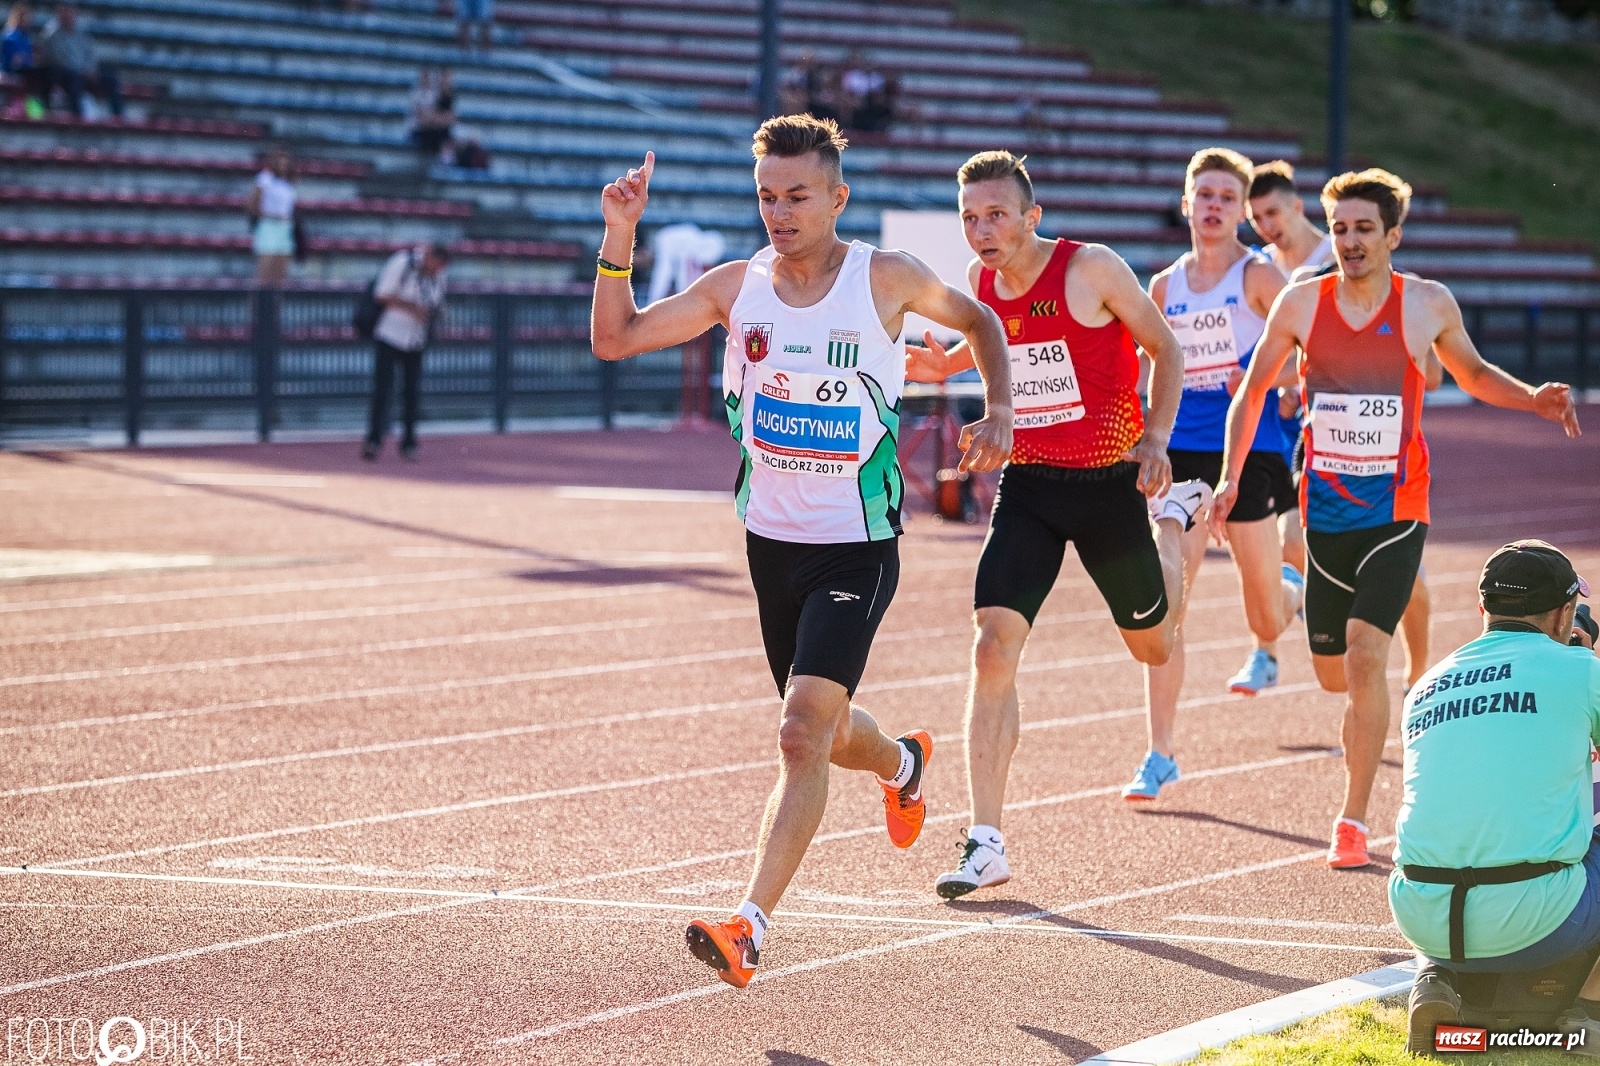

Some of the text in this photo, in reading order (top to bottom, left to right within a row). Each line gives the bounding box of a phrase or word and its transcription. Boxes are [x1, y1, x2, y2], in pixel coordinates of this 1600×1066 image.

[1193, 311, 1227, 331] 606
[1028, 345, 1065, 366] 548
[763, 385, 788, 399] ORLEN
[815, 380, 848, 402] 69
[1011, 375, 1074, 397] SACZYŃSKI
[1359, 398, 1398, 417] 285
[756, 408, 857, 440] AUGUSTYNIAK
[1013, 411, 1073, 427] ACIBÓRZ 2019
[1329, 428, 1382, 446] TURSKI
[761, 453, 844, 474] RACIBÓRZ 2019
[1322, 460, 1387, 473] RACIBÓRZ 2019
[829, 590, 861, 600] BROOKS
[1414, 662, 1512, 706] OBSŁUGA
[1407, 691, 1538, 739] TECHNICZNA
